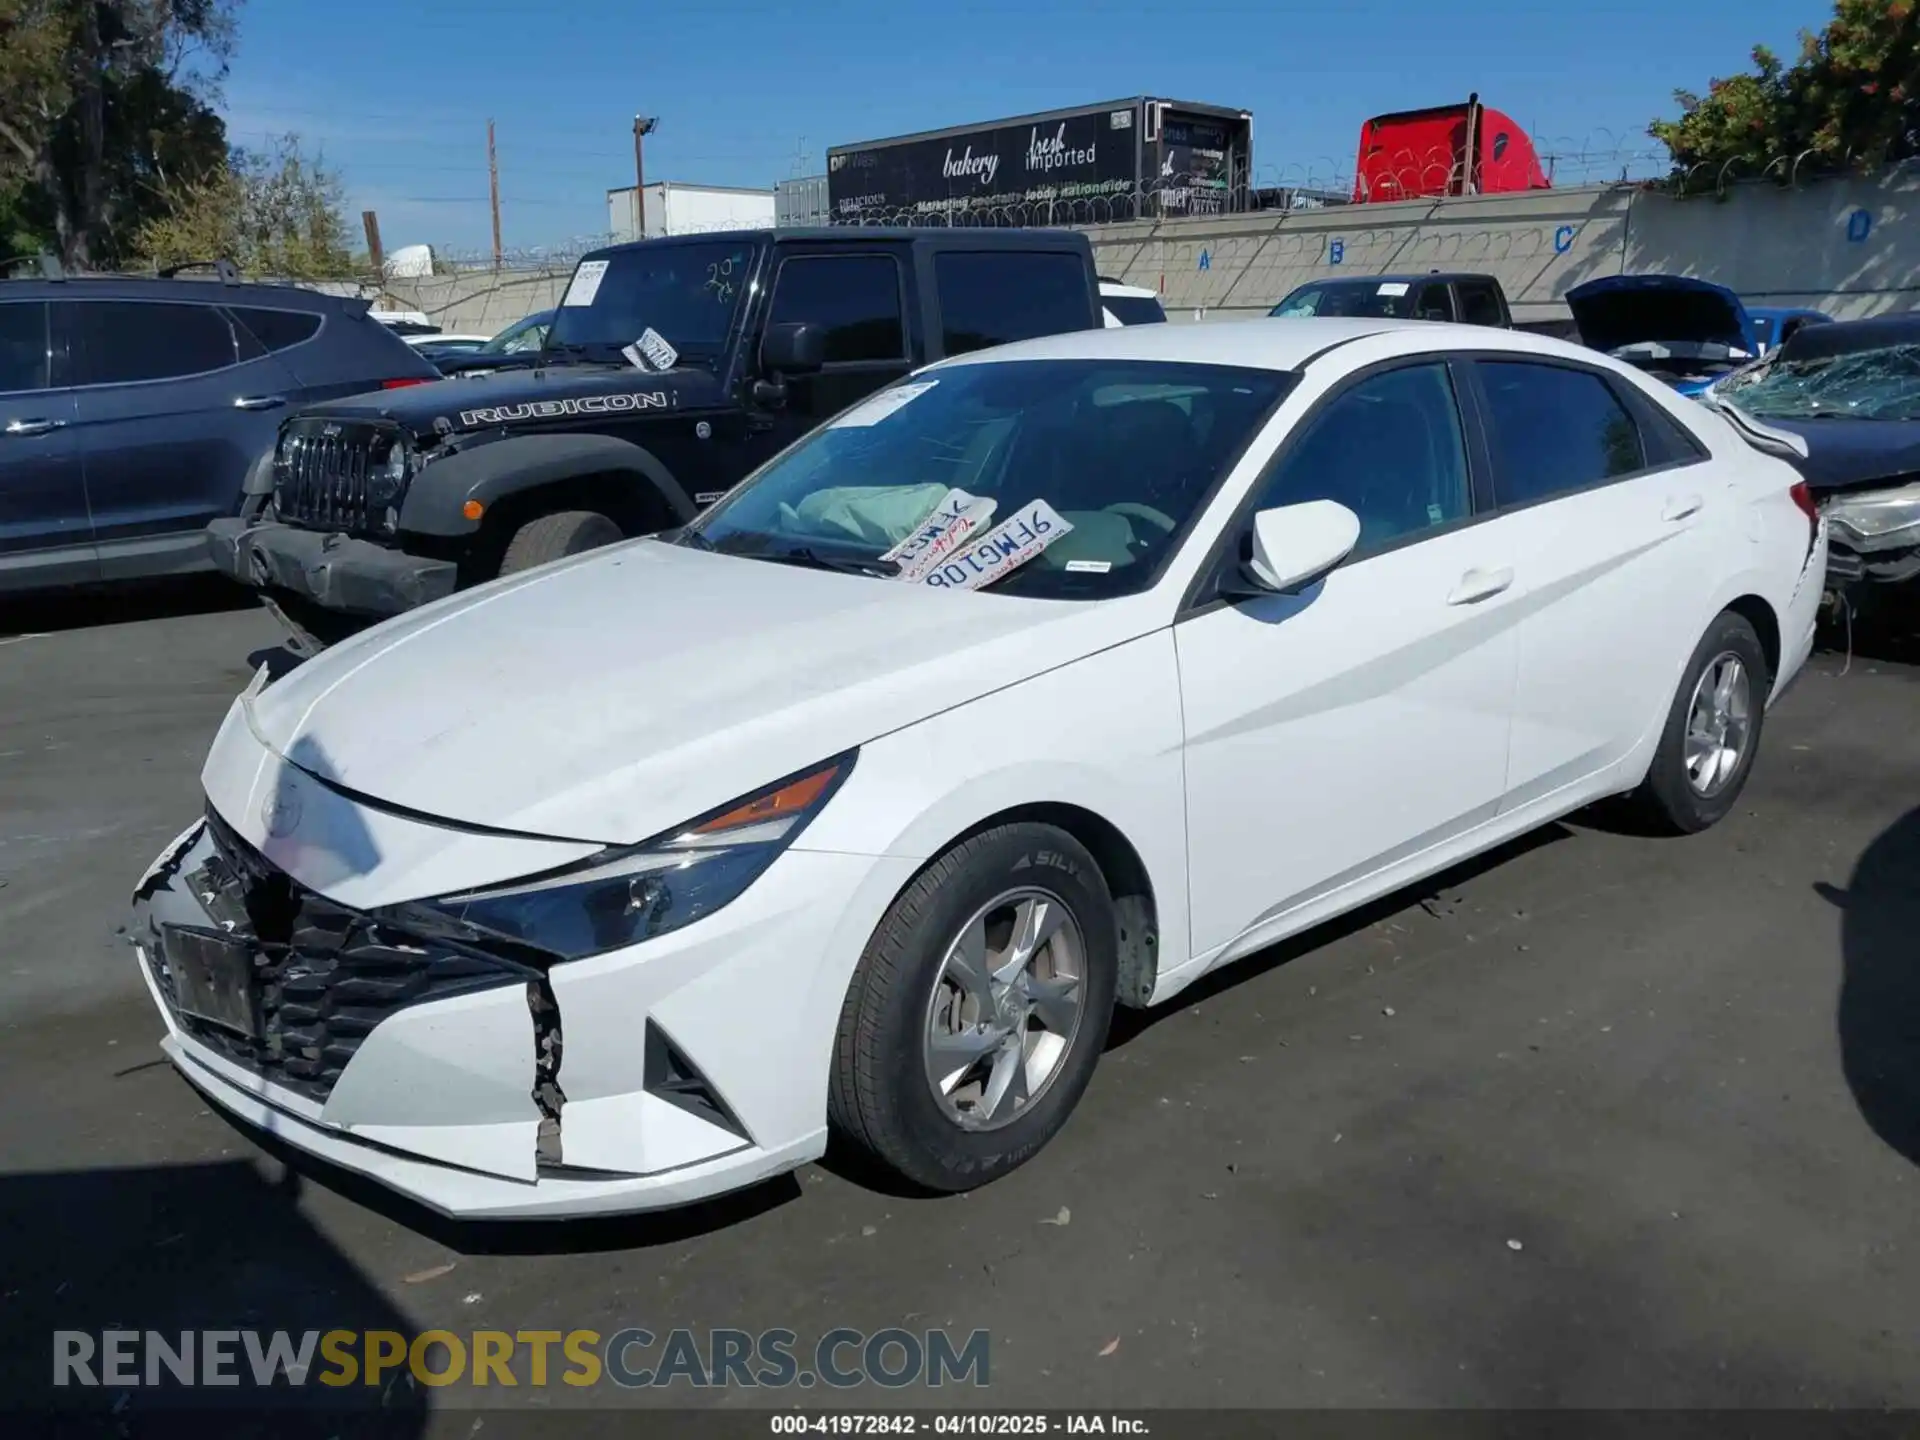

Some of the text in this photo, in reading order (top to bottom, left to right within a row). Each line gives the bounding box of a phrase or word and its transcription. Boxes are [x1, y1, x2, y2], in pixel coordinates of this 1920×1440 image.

[942, 145, 1000, 184] bakery
[1025, 142, 1096, 172] imported
[1060, 178, 1132, 199] nationwide
[1554, 225, 1572, 253] C
[1847, 208, 1871, 242] D
[1199, 247, 1210, 271] A
[460, 391, 668, 425] RUBICON
[926, 510, 1051, 590] 9FMG108
